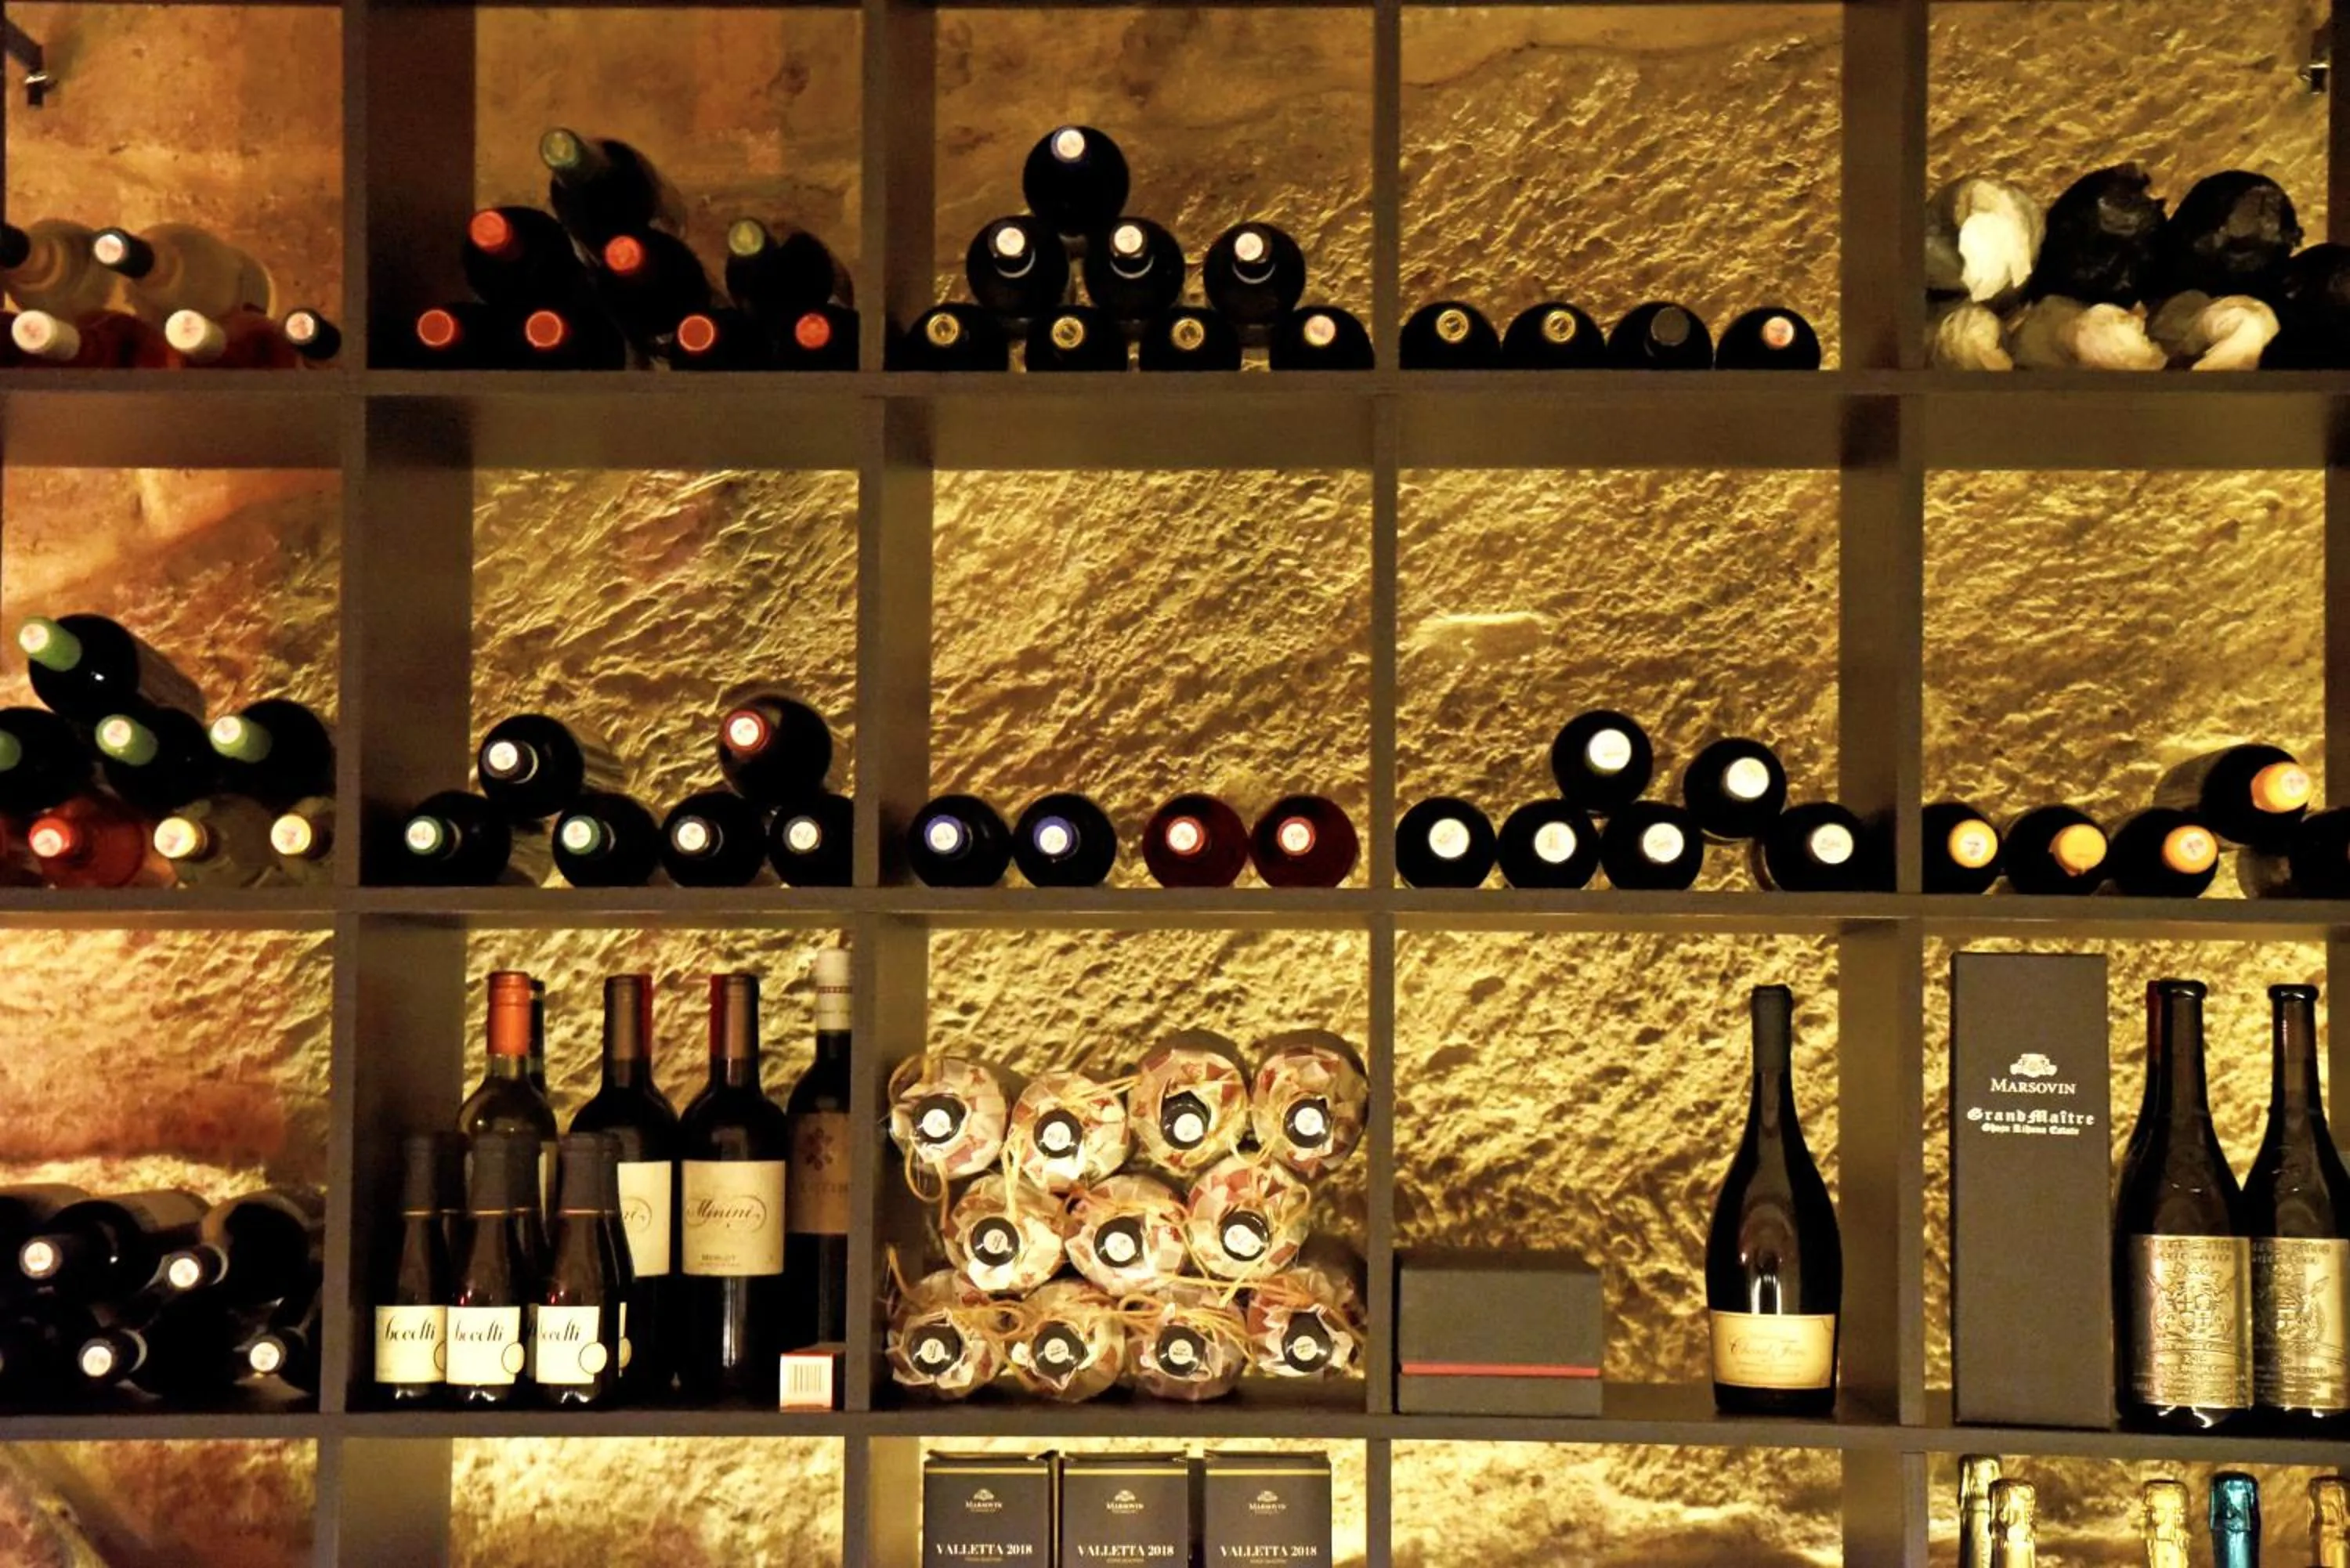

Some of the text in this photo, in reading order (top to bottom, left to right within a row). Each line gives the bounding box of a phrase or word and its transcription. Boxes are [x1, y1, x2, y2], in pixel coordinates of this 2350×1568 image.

[1990, 1078, 2077, 1094] MARSOVIN
[936, 1543, 1033, 1555] VALLETTA 2018
[1077, 1545, 1175, 1557] VALLETTA 2018
[1220, 1545, 1318, 1557] VALLETTA 2018
